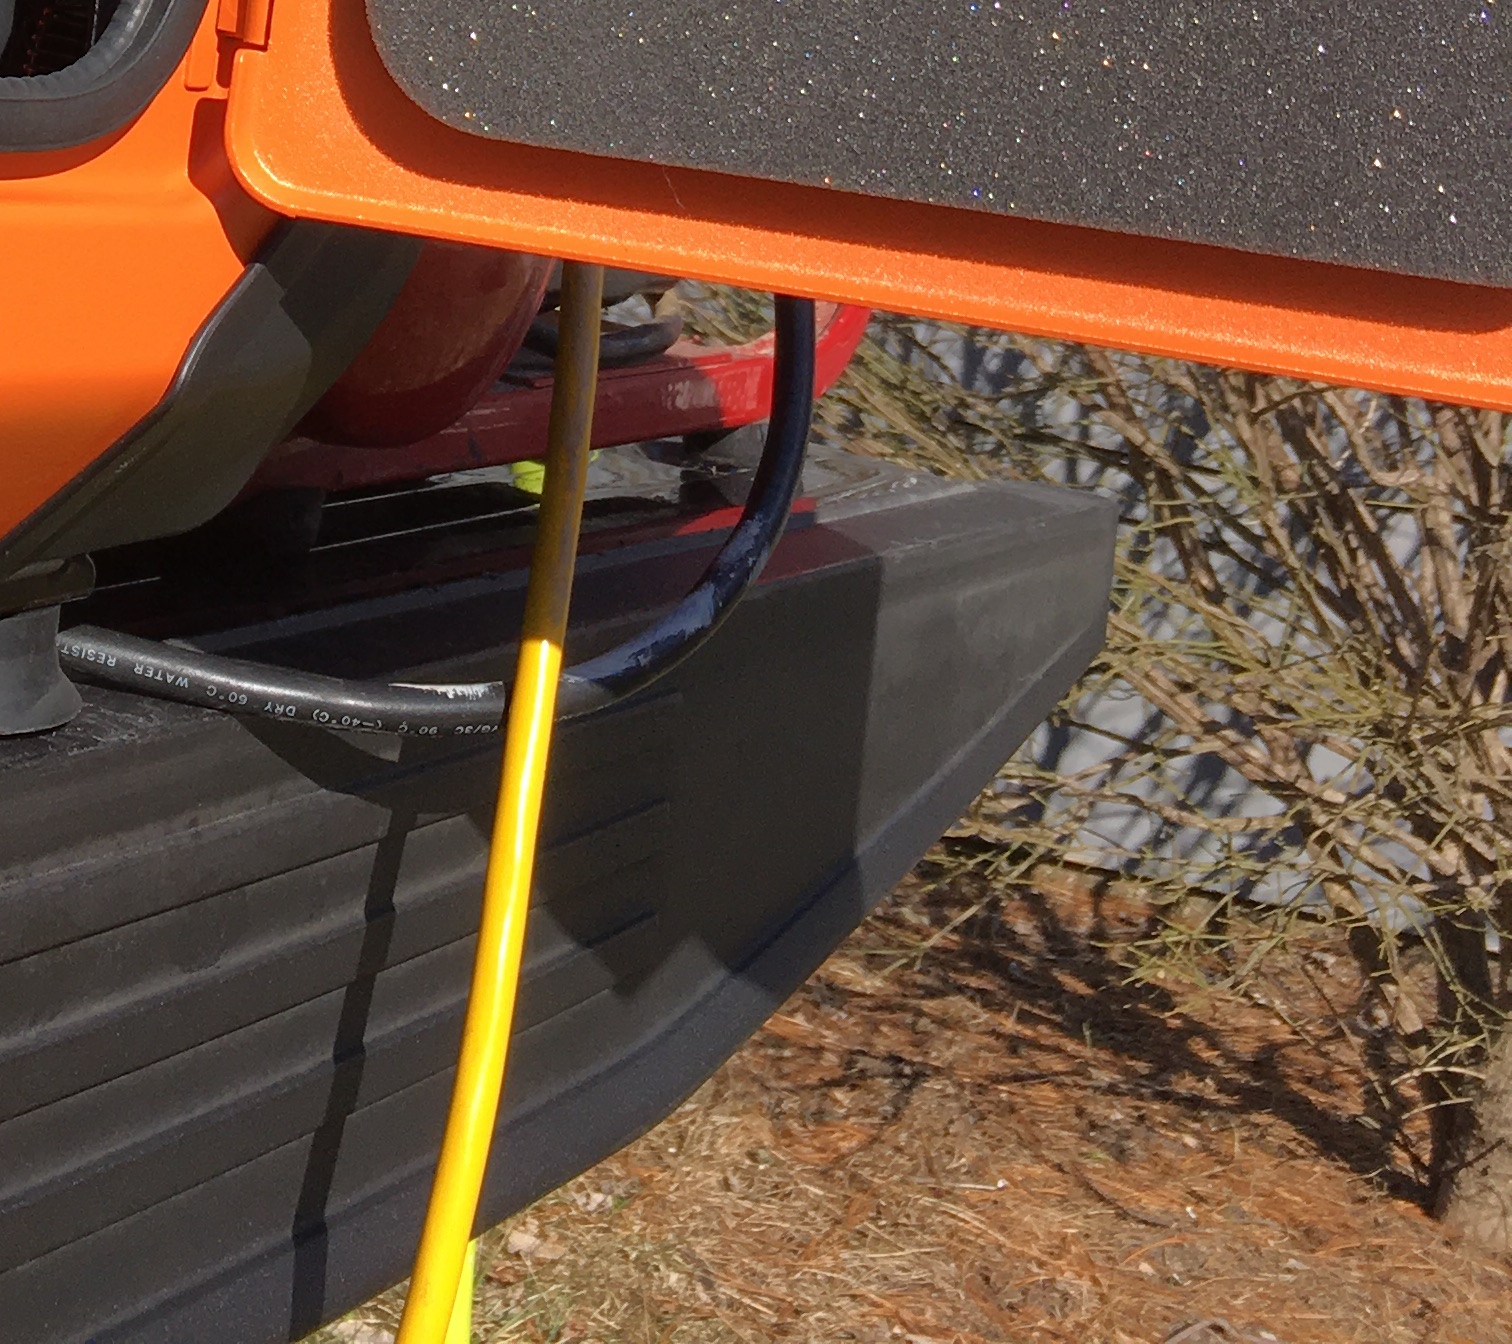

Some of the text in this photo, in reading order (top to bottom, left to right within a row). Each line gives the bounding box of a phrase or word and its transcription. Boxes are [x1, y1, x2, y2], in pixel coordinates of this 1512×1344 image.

[133, 661, 190, 689] WATER
[205, 684, 249, 706] 60°C
[263, 701, 297, 717] DRY
